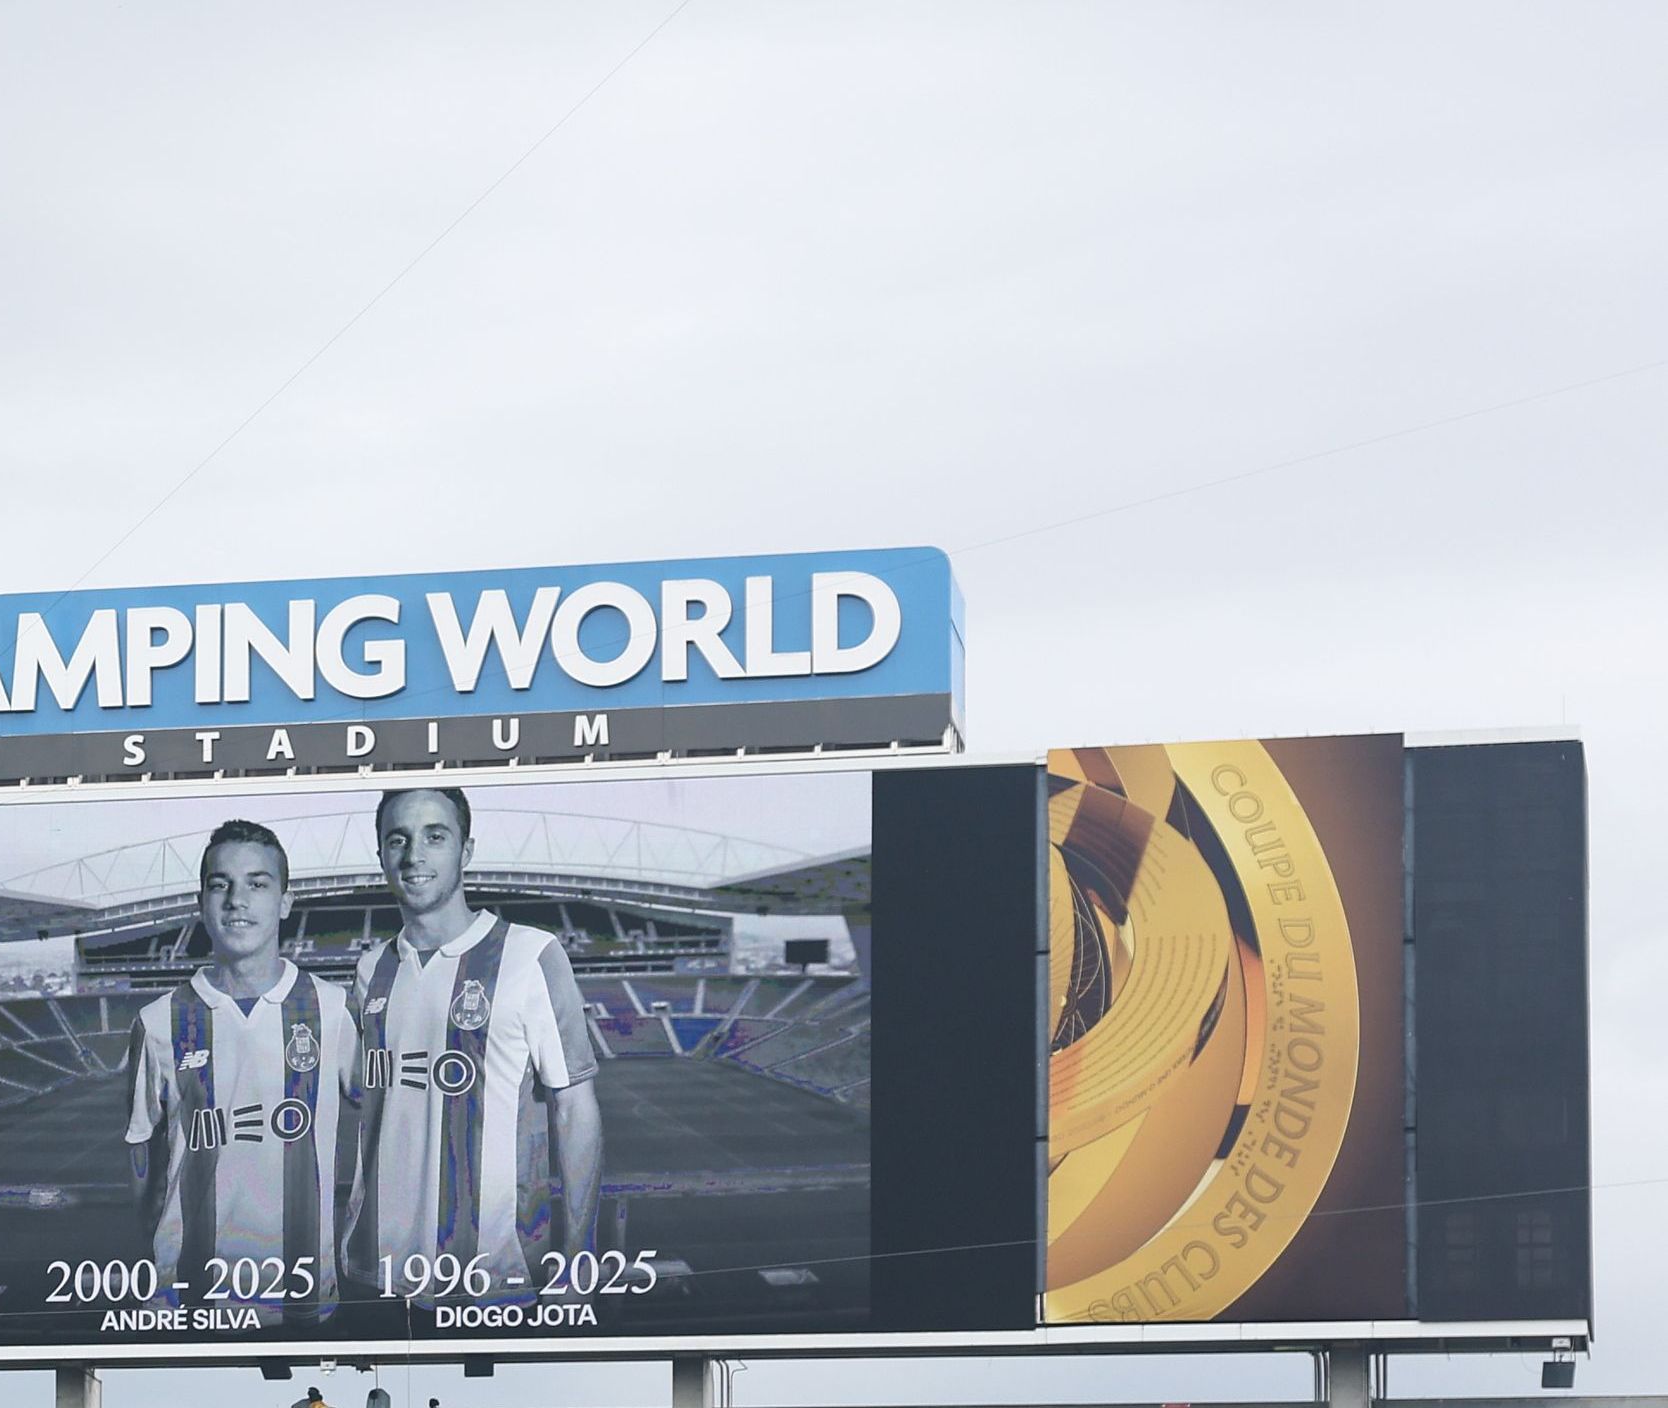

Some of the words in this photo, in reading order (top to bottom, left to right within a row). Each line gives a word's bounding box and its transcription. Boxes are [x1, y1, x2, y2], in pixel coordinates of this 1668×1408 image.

[427, 571, 902, 691] WORLD
[123, 715, 610, 767] STADIUM
[1210, 763, 1306, 907] COUPE
[1277, 917, 1325, 985] DU
[1261, 999, 1329, 1169] MONDE
[1213, 1167, 1287, 1252] DES
[45, 1257, 158, 1303] 2000
[204, 1254, 315, 1301] 2025
[379, 1252, 491, 1299] 1996
[540, 1248, 658, 1297] 2025
[100, 1303, 188, 1331] ANDRÉ
[191, 1308, 261, 1330] SILVA
[436, 1305, 524, 1329] DIOGO
[527, 1303, 598, 1327] JOTA
